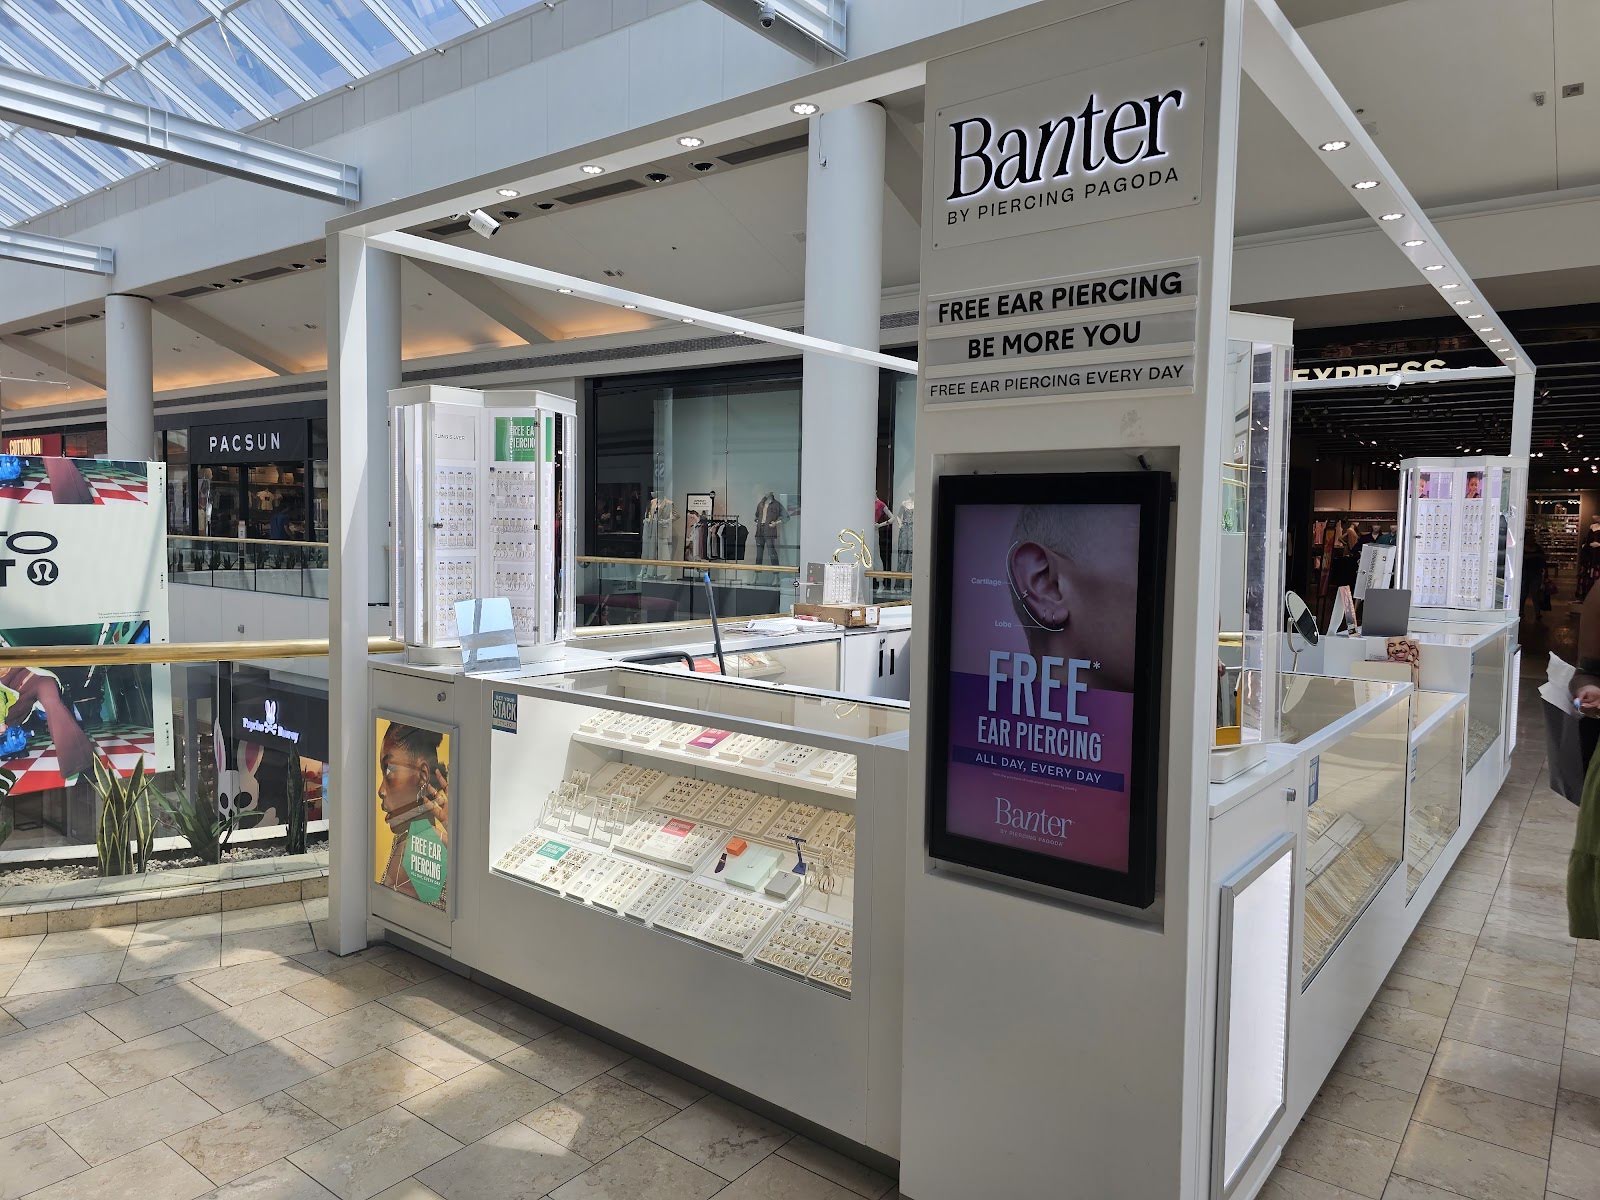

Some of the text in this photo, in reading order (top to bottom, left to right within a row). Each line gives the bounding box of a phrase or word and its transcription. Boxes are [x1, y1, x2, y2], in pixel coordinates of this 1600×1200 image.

[947, 88, 1183, 201] Banter
[947, 167, 1179, 225] BY PIERCING PAGODA
[938, 271, 1182, 323] FREE EAR PIERCING
[968, 320, 1141, 359] BE MORE YOU
[930, 364, 1185, 397] FREE EAR PIERCING EVERY DAY
[9, 437, 41, 455] COTTON ON
[209, 432, 280, 453] PACSUN
[510, 437, 536, 449] PIERCIN
[526, 425, 535, 437] EA
[493, 700, 517, 721] STACK
[977, 716, 1102, 762] EAR PIERCING
[975, 753, 997, 765] ALL
[1001, 757, 1027, 772] DAY,
[1031, 762, 1072, 778] EVERY
[1076, 771, 1102, 784] DAY
[994, 796, 1072, 839] Banter
[411, 835, 442, 861] FREE EAR
[411, 854, 441, 881] PIERCING
